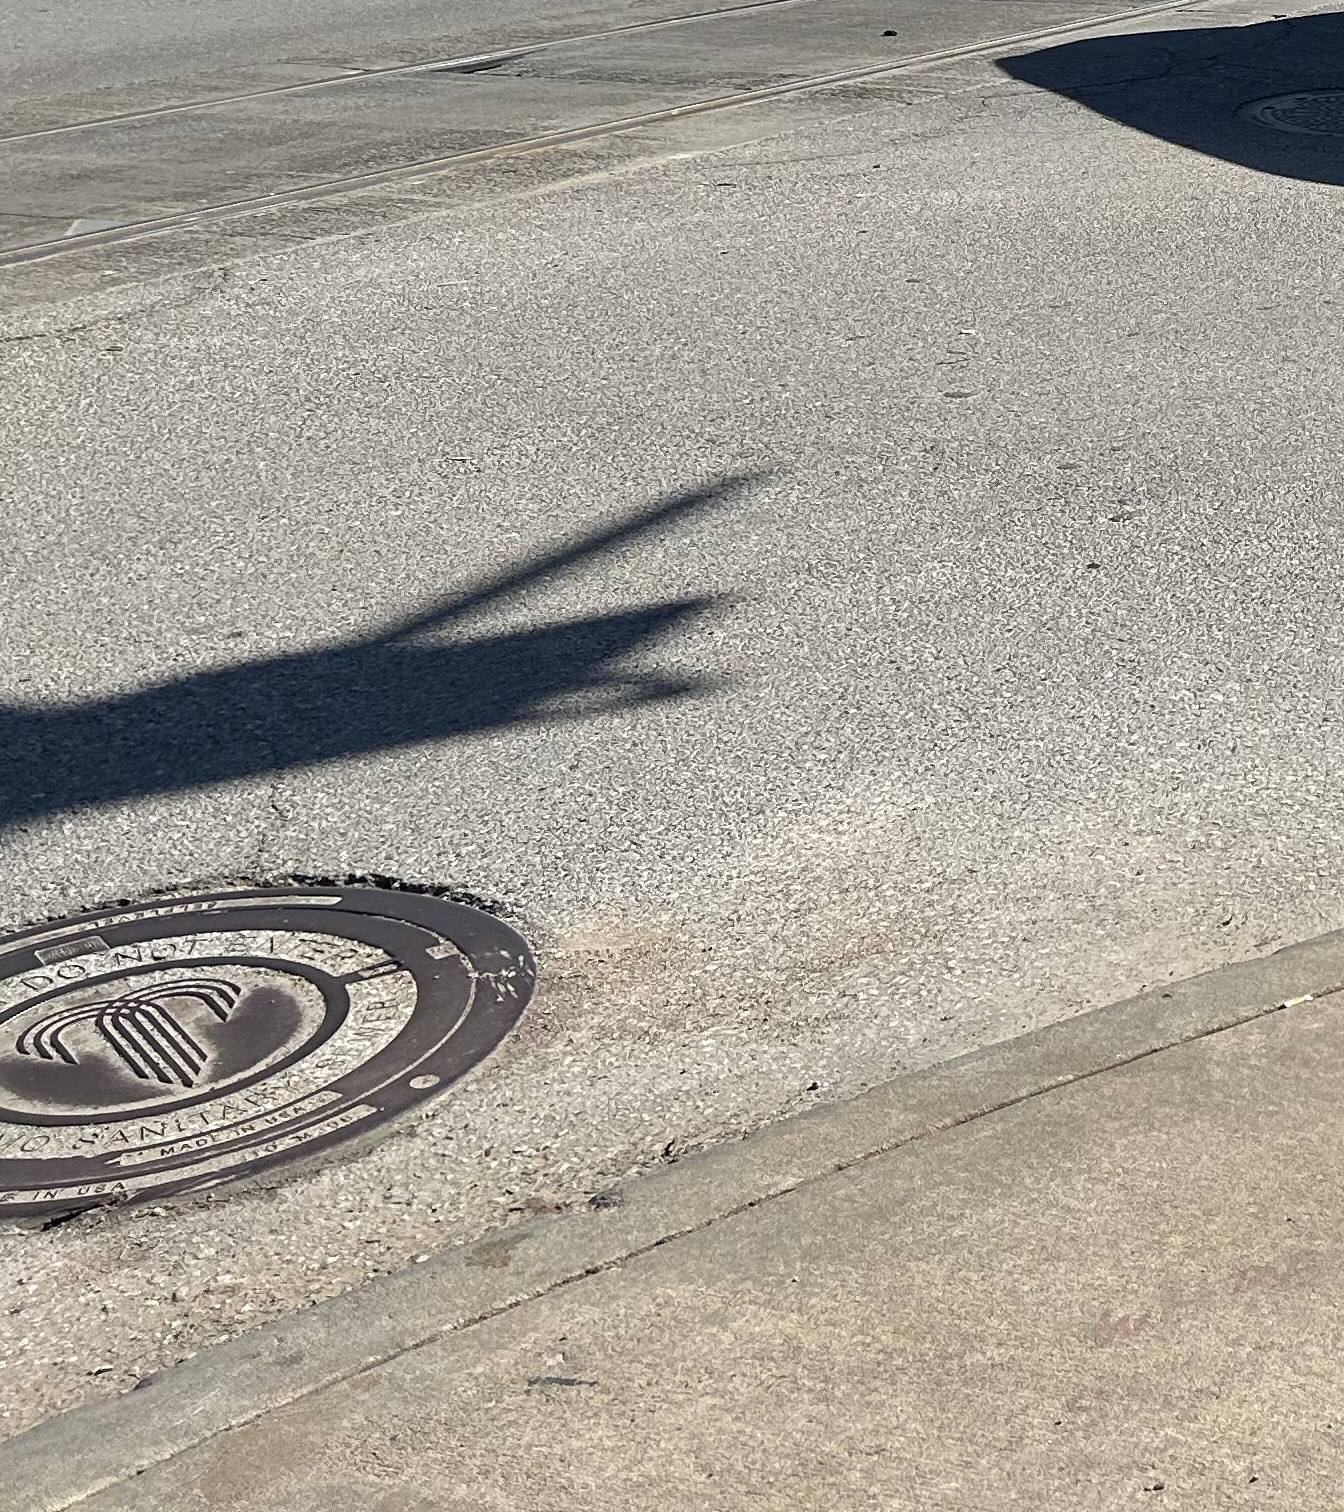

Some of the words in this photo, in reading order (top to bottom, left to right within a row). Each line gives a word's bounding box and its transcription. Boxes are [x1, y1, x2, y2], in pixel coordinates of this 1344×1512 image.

[20, 964, 86, 990] DO
[114, 939, 200, 965] NOT
[160, 1131, 222, 1157] MADE
[33, 1190, 58, 1201] IN
[77, 1181, 127, 1196] USA
